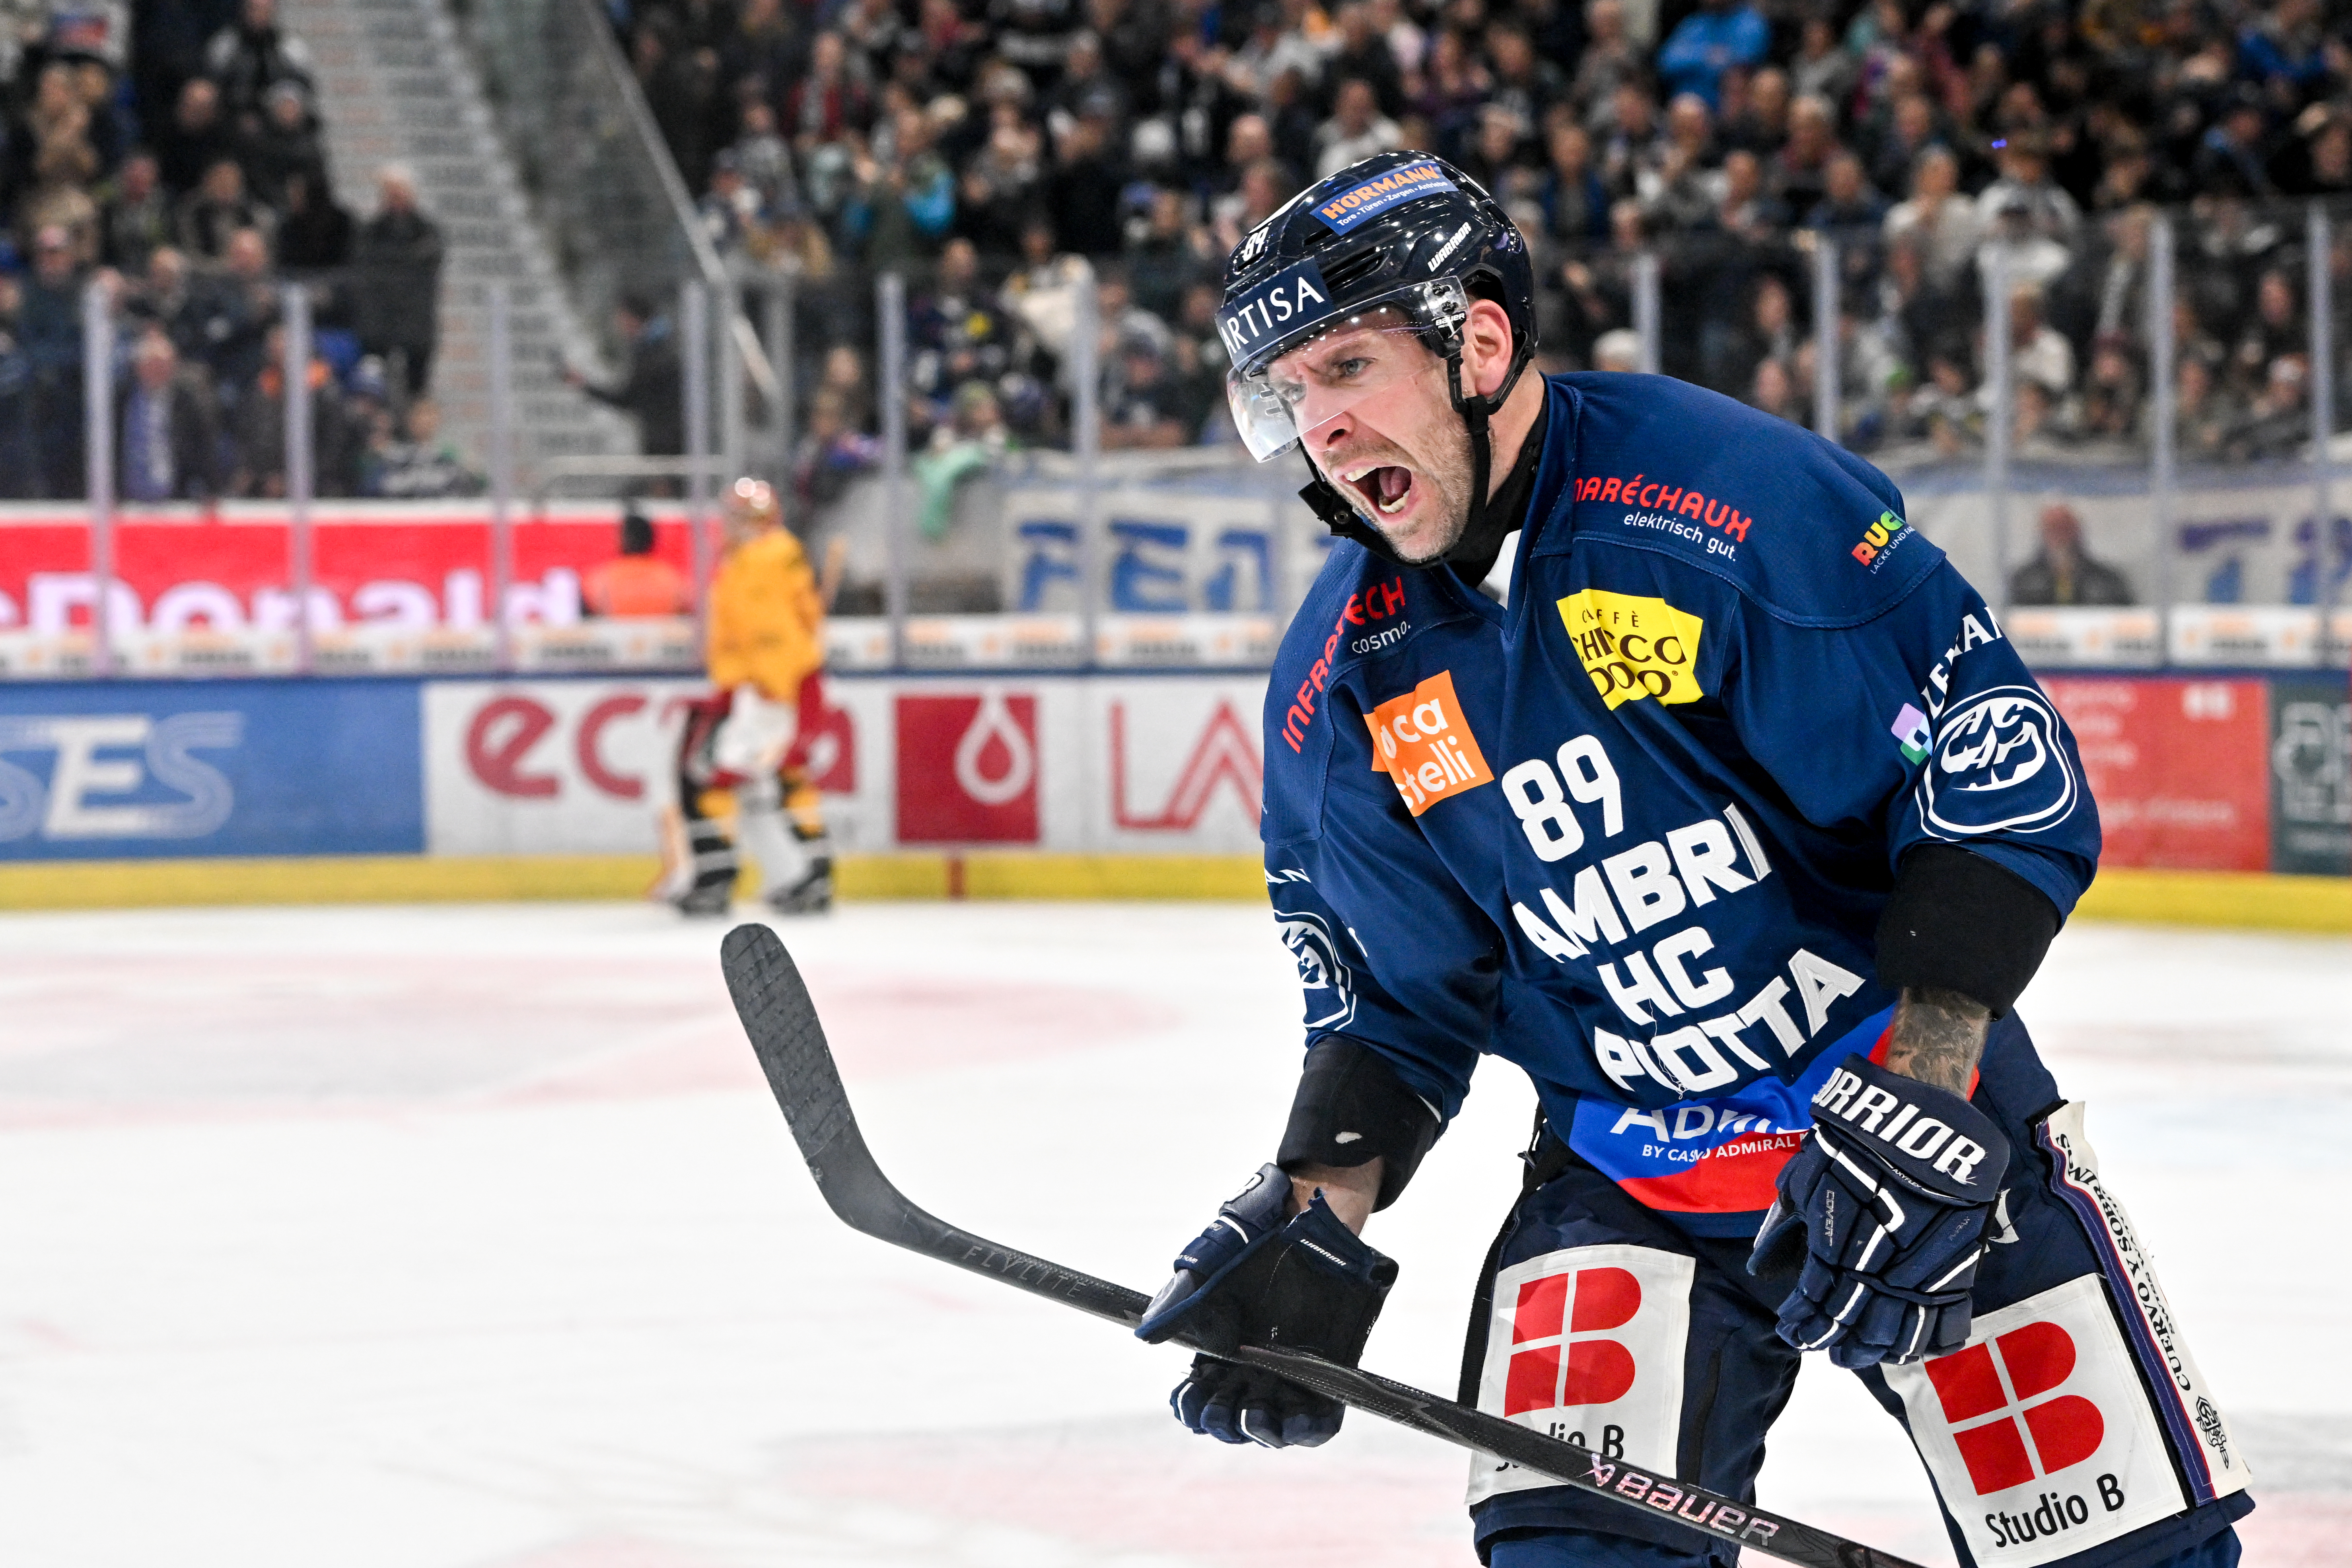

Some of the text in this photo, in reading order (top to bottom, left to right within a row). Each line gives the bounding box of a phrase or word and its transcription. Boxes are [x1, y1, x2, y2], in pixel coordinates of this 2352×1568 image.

[1321, 165, 1439, 220] HÖRMANN
[1336, 181, 1448, 226] Tore Türen Zargen Antriebe
[1243, 227, 1269, 261] 89
[1428, 222, 1472, 272] WARRIOR
[1221, 276, 1325, 359] ARTISA
[1623, 512, 1736, 562] elektrisch gut.
[1852, 509, 1906, 566] RUC
[1870, 549, 1891, 574] LACKE
[1889, 532, 1906, 549] UND
[1502, 734, 1623, 862] 89
[1512, 802, 1772, 963] AMBRI
[1597, 926, 1734, 1026] HC
[1594, 948, 1866, 1092] PIOTTA
[1642, 1144, 1665, 1158] BY
[1715, 1137, 1795, 1158] ADMIRAL
[960, 1245, 1088, 1298] FLYLITE
[1300, 1238, 1346, 1266] WARRIOR
[2125, 1258, 2141, 1279] Y
[2134, 1282, 2191, 1391] CUERVO
[1985, 1473, 2125, 1549] Studio B
